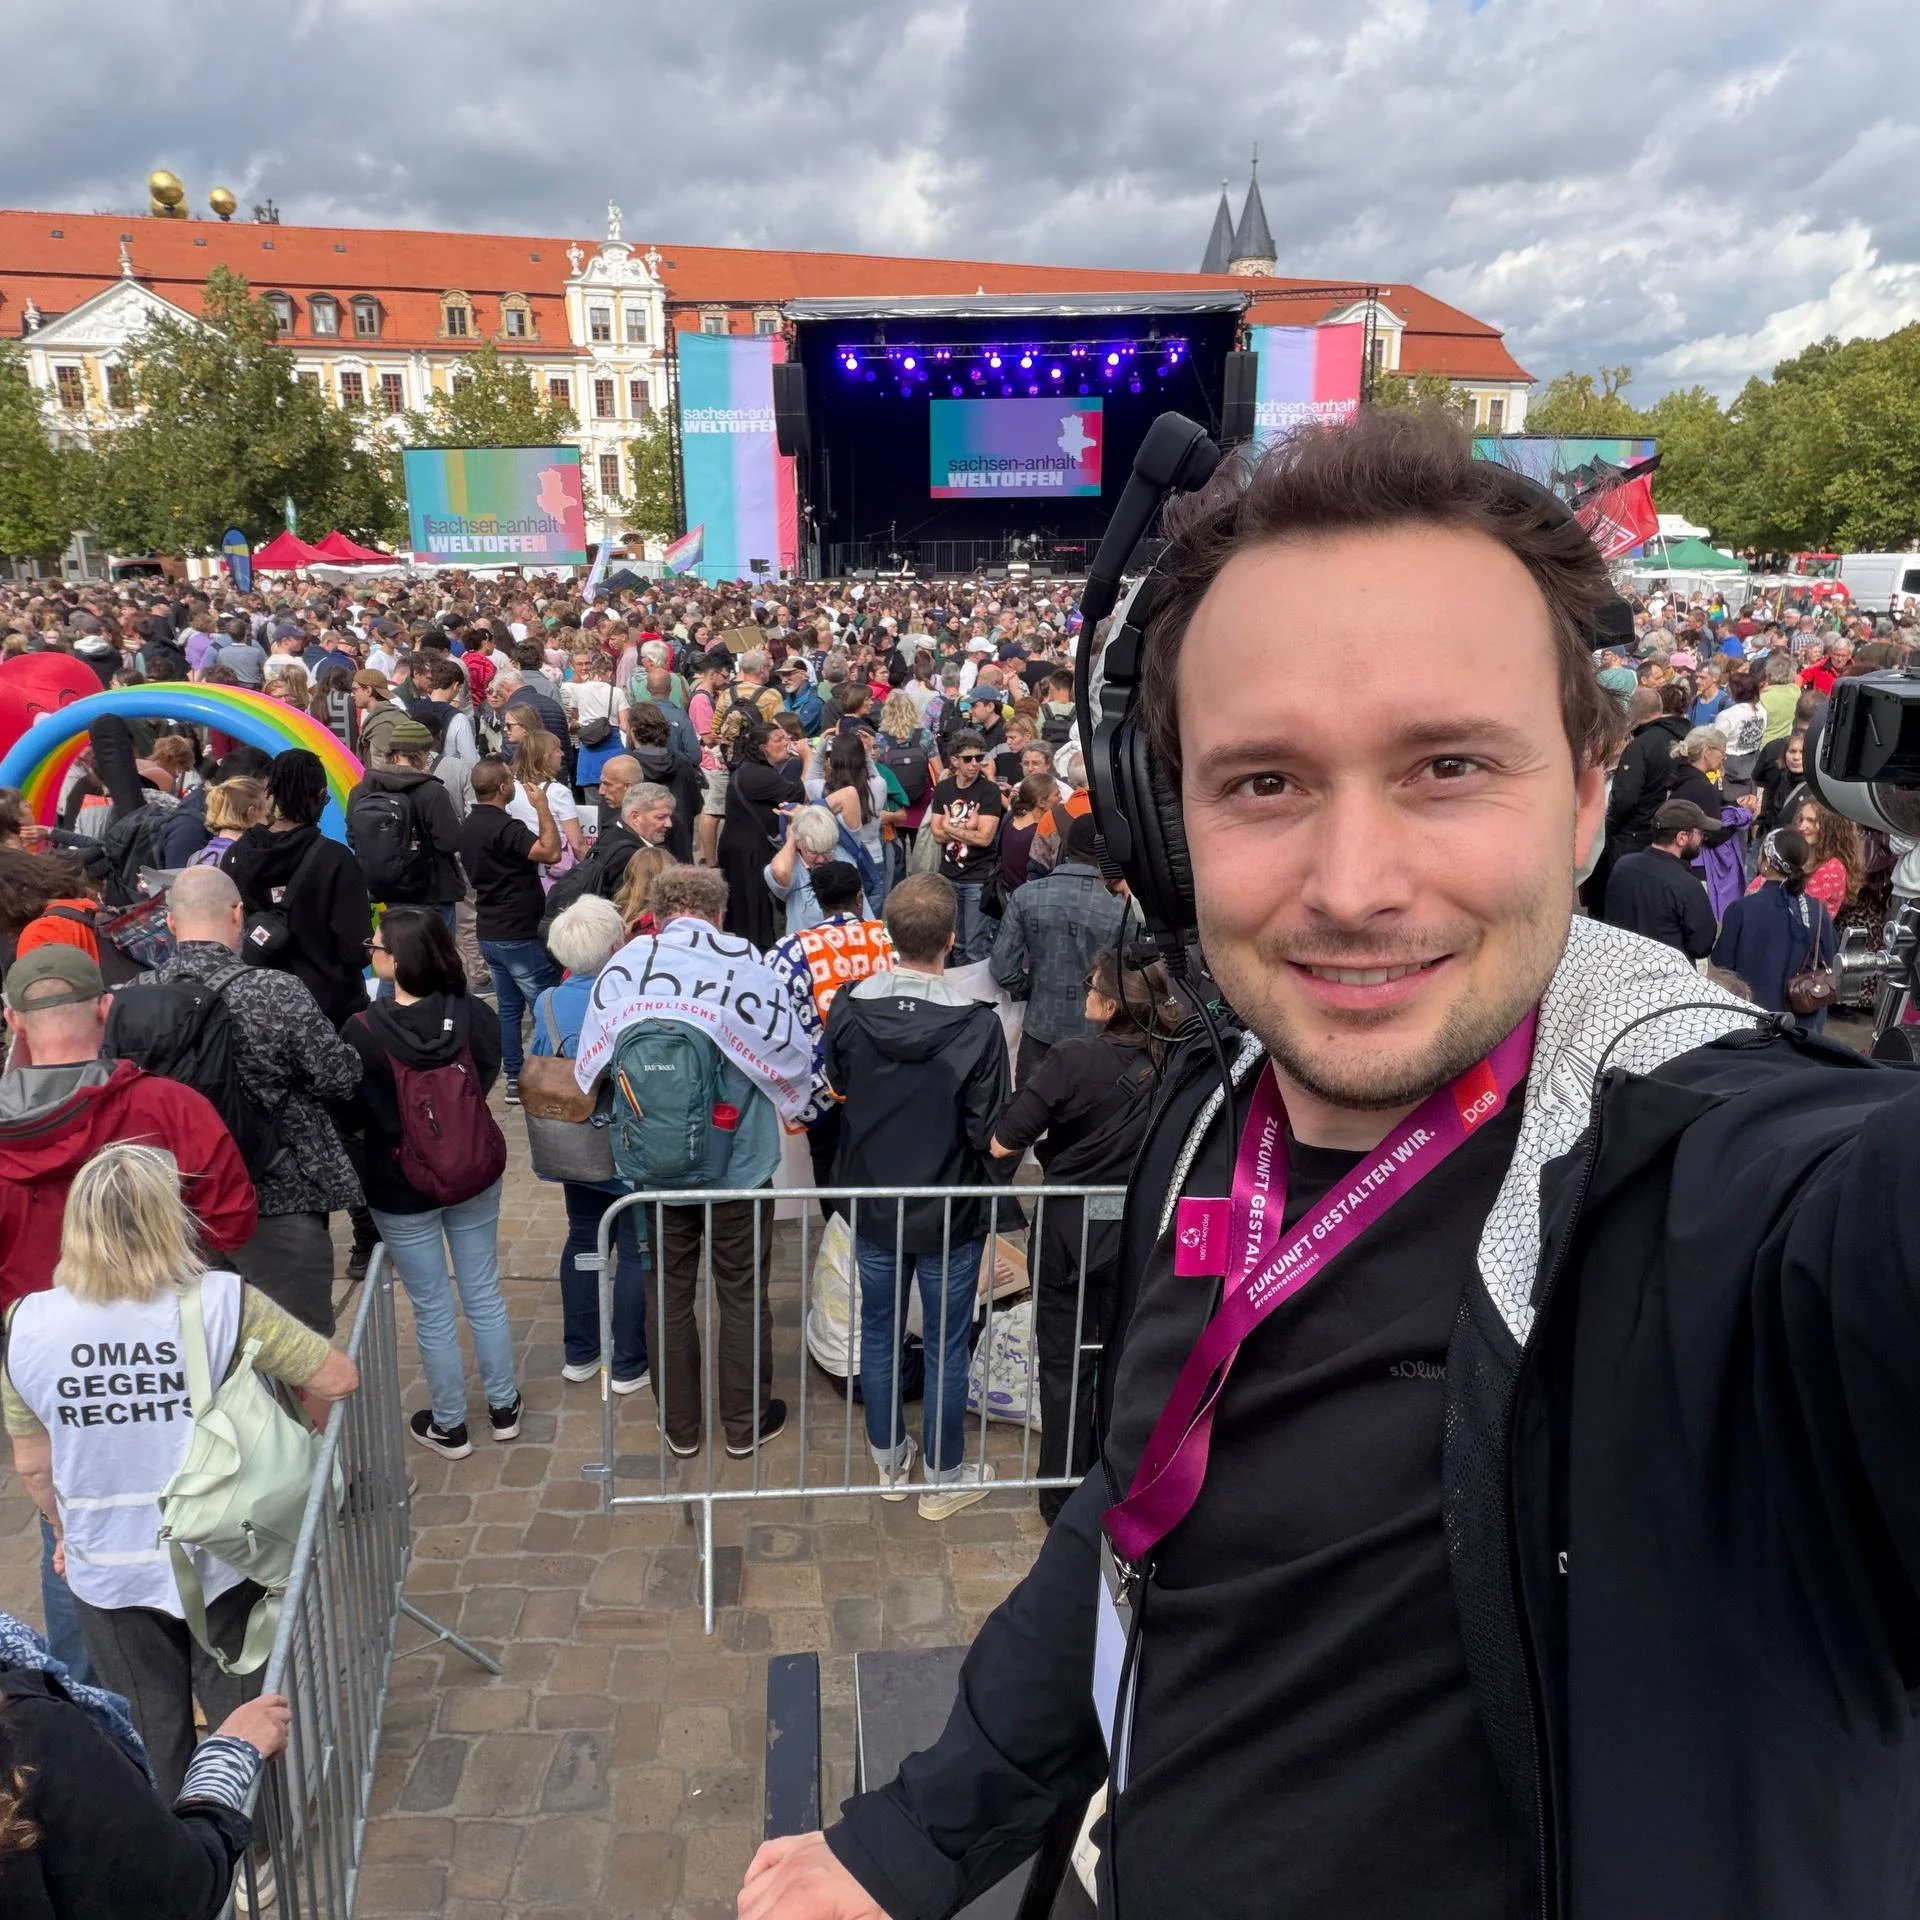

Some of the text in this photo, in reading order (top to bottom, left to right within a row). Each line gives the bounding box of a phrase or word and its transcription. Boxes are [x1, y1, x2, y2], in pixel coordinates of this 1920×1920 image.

[948, 455, 1077, 472] sachsen-anhalt
[947, 471, 1064, 488] WELTOFFEN
[428, 515, 560, 534] sachsen-anhalt
[428, 535, 549, 553] WELTOFFEN
[622, 1002, 717, 1023] KATHOLISCHE
[1463, 1090, 1498, 1124] DGB
[1254, 1116, 1279, 1191] ZUKUNFT
[1246, 1128, 1436, 1302] ZUKUNFT GESTALTEN WIR.
[1254, 1252, 1320, 1310] #rechnetmituns
[71, 1341, 178, 1368] OMAS
[56, 1371, 186, 1399] GEGEN
